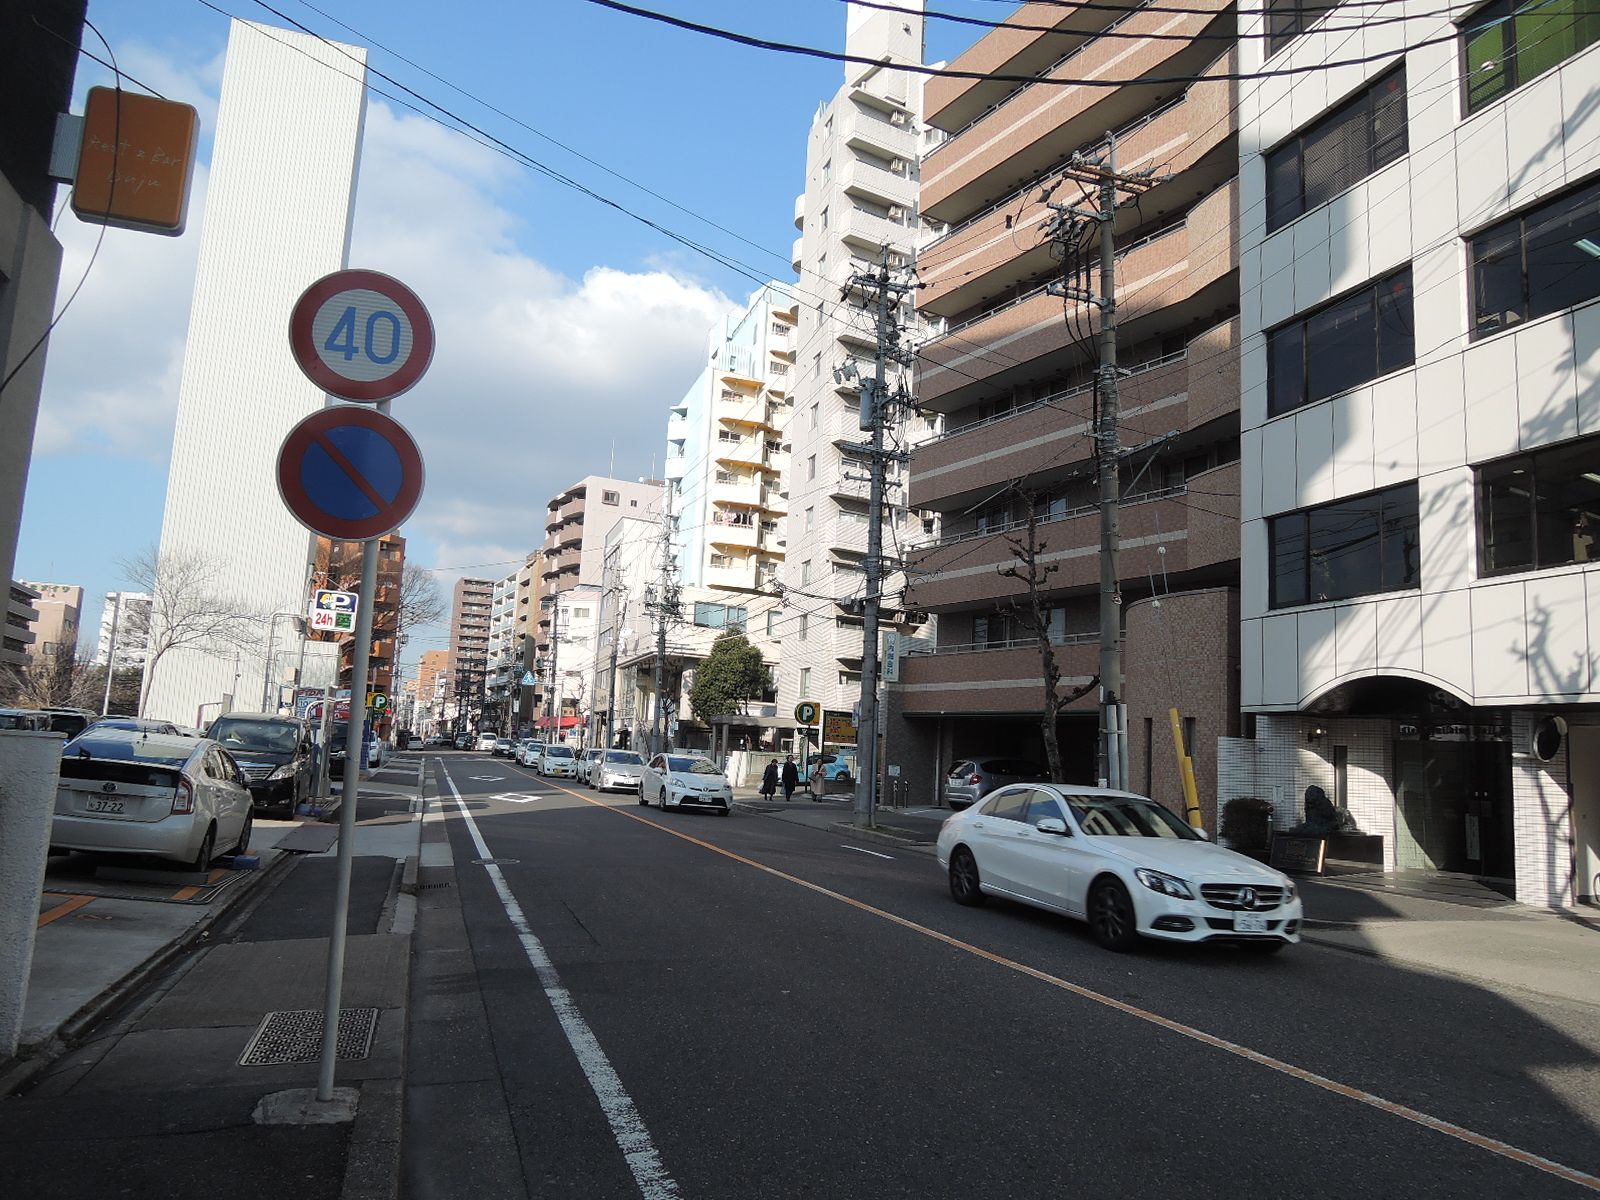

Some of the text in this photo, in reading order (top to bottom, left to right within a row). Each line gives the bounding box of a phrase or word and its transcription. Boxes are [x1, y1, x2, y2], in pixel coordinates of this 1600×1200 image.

[324, 306, 401, 365] 40
[315, 612, 333, 626] 24h
[803, 706, 813, 721] P
